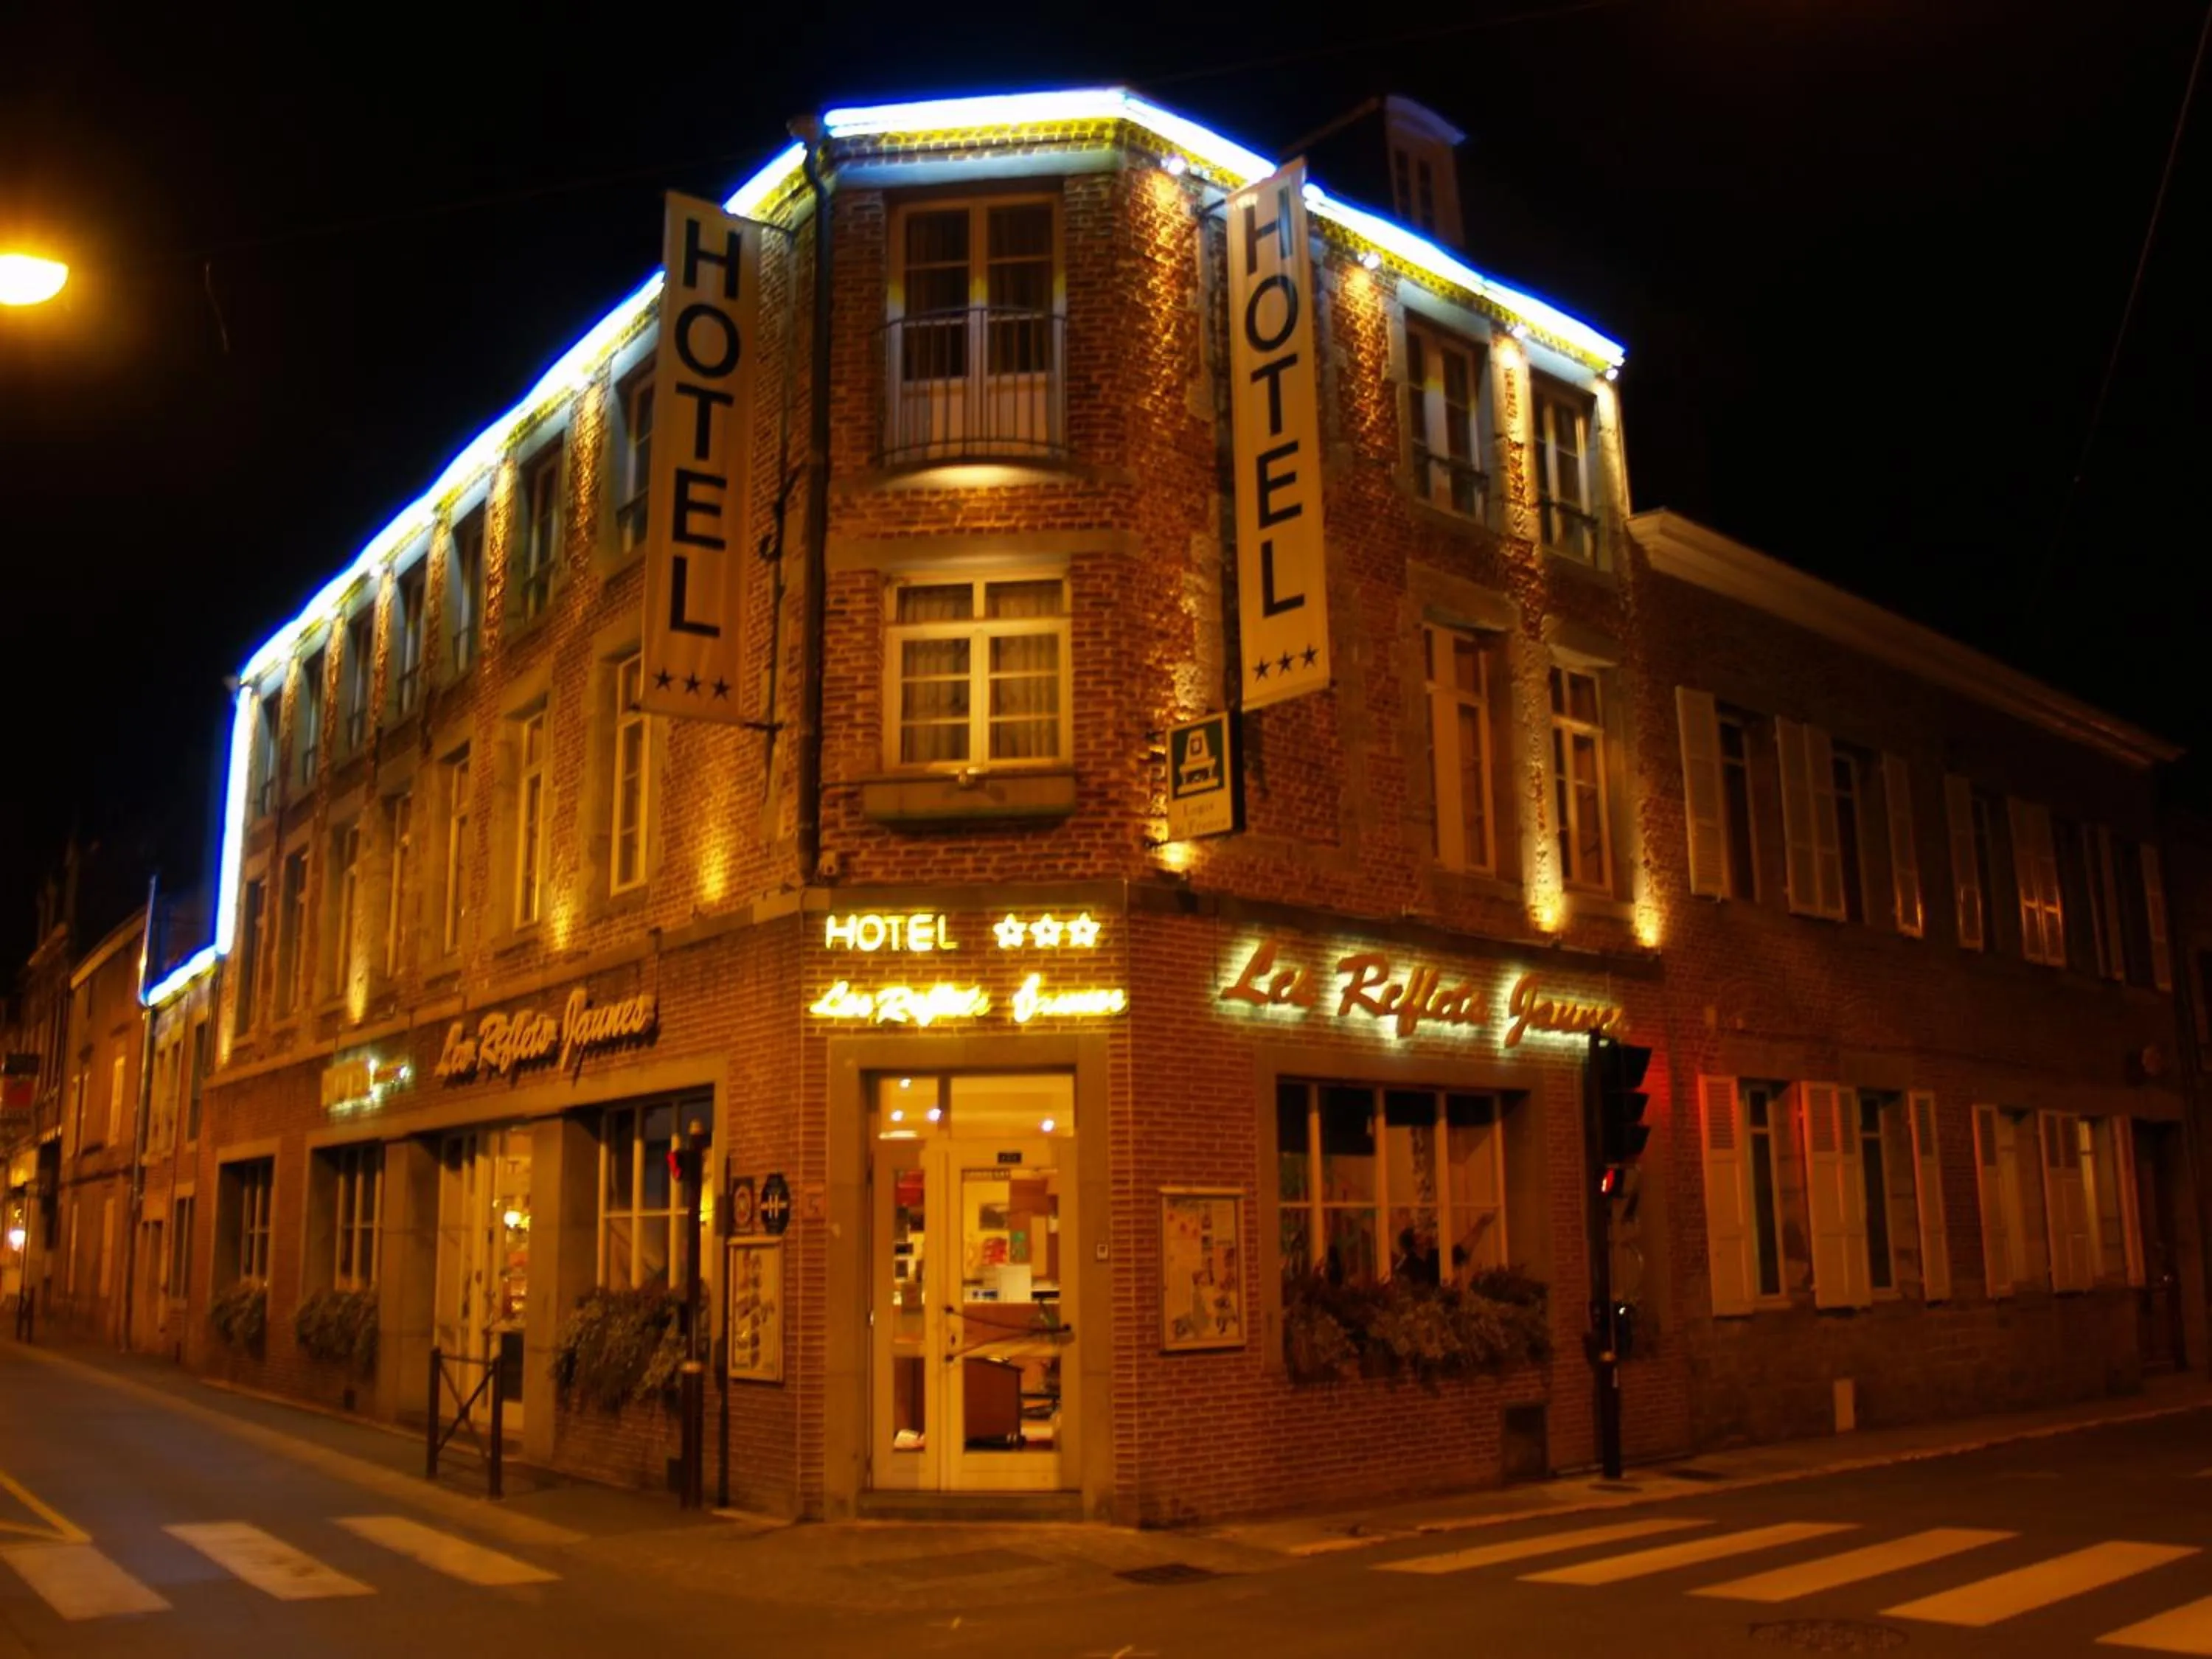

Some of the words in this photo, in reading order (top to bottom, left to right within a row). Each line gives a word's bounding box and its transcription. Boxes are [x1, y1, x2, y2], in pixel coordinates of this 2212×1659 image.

[670, 218, 741, 638] HOTEL
[1244, 186, 1306, 619] HOTEL
[824, 913, 958, 953] HOTEL
[1219, 938, 1317, 1010] Les
[558, 987, 654, 1073] Jaunes
